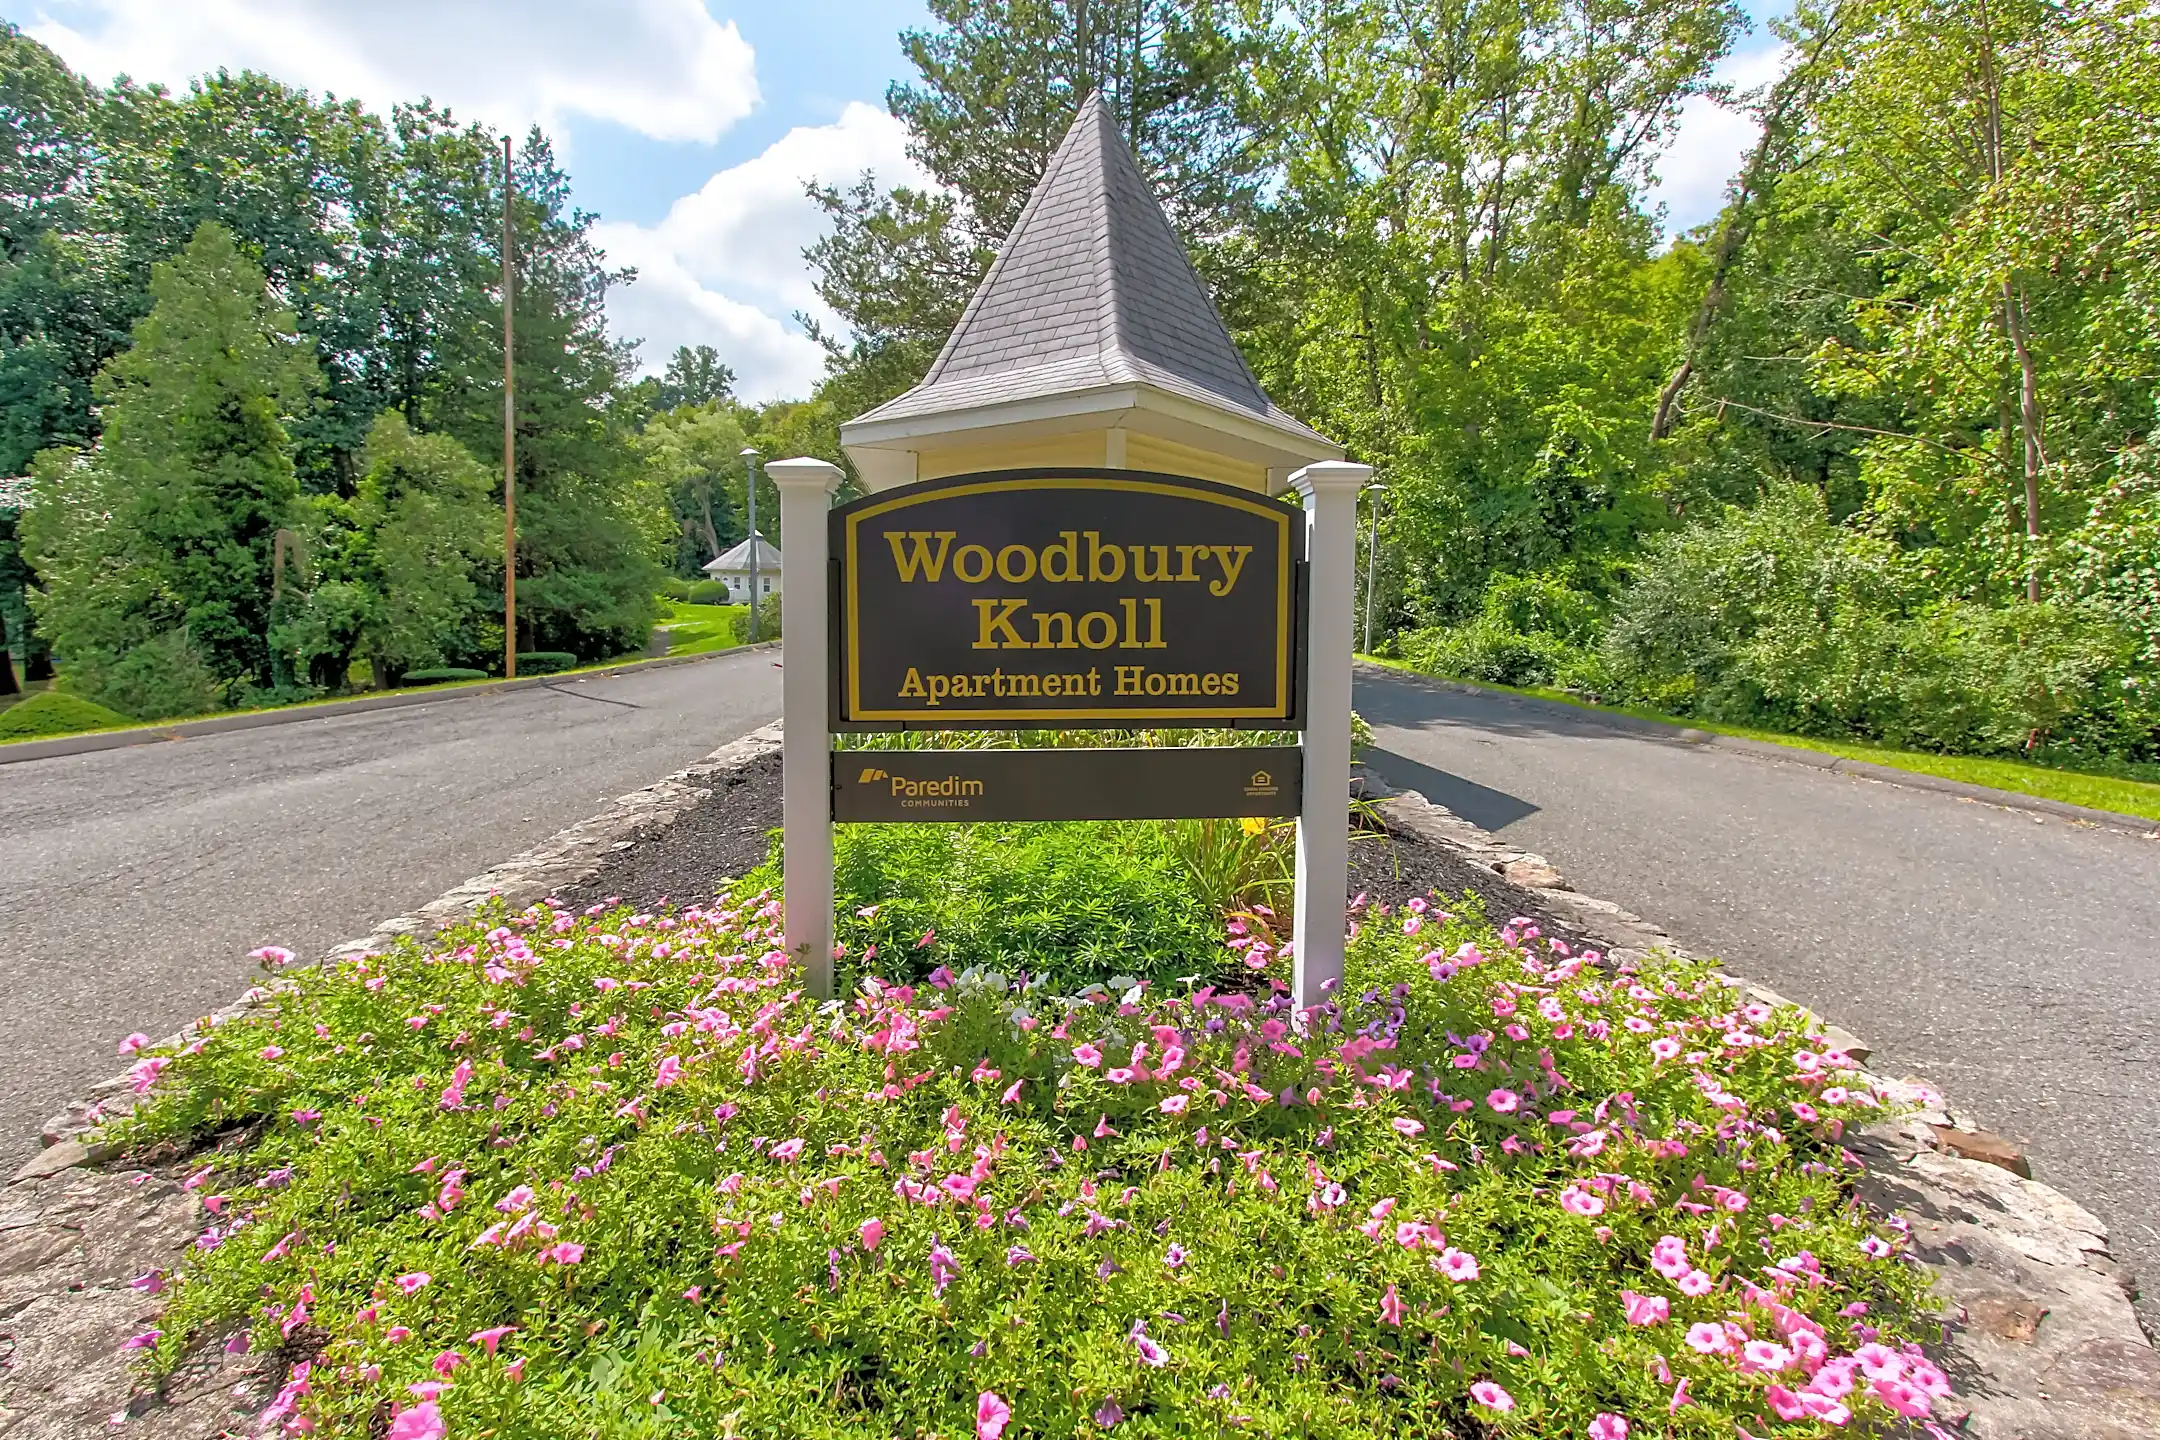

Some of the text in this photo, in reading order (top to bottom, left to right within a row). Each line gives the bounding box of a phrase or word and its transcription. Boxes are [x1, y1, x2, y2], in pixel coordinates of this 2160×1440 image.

[884, 531, 1253, 597] Woodbury
[971, 598, 1167, 649] Knoll
[898, 665, 1240, 706] Apartment Homes
[891, 776, 984, 797] Paredim
[900, 799, 970, 808] COMMUNITIES
